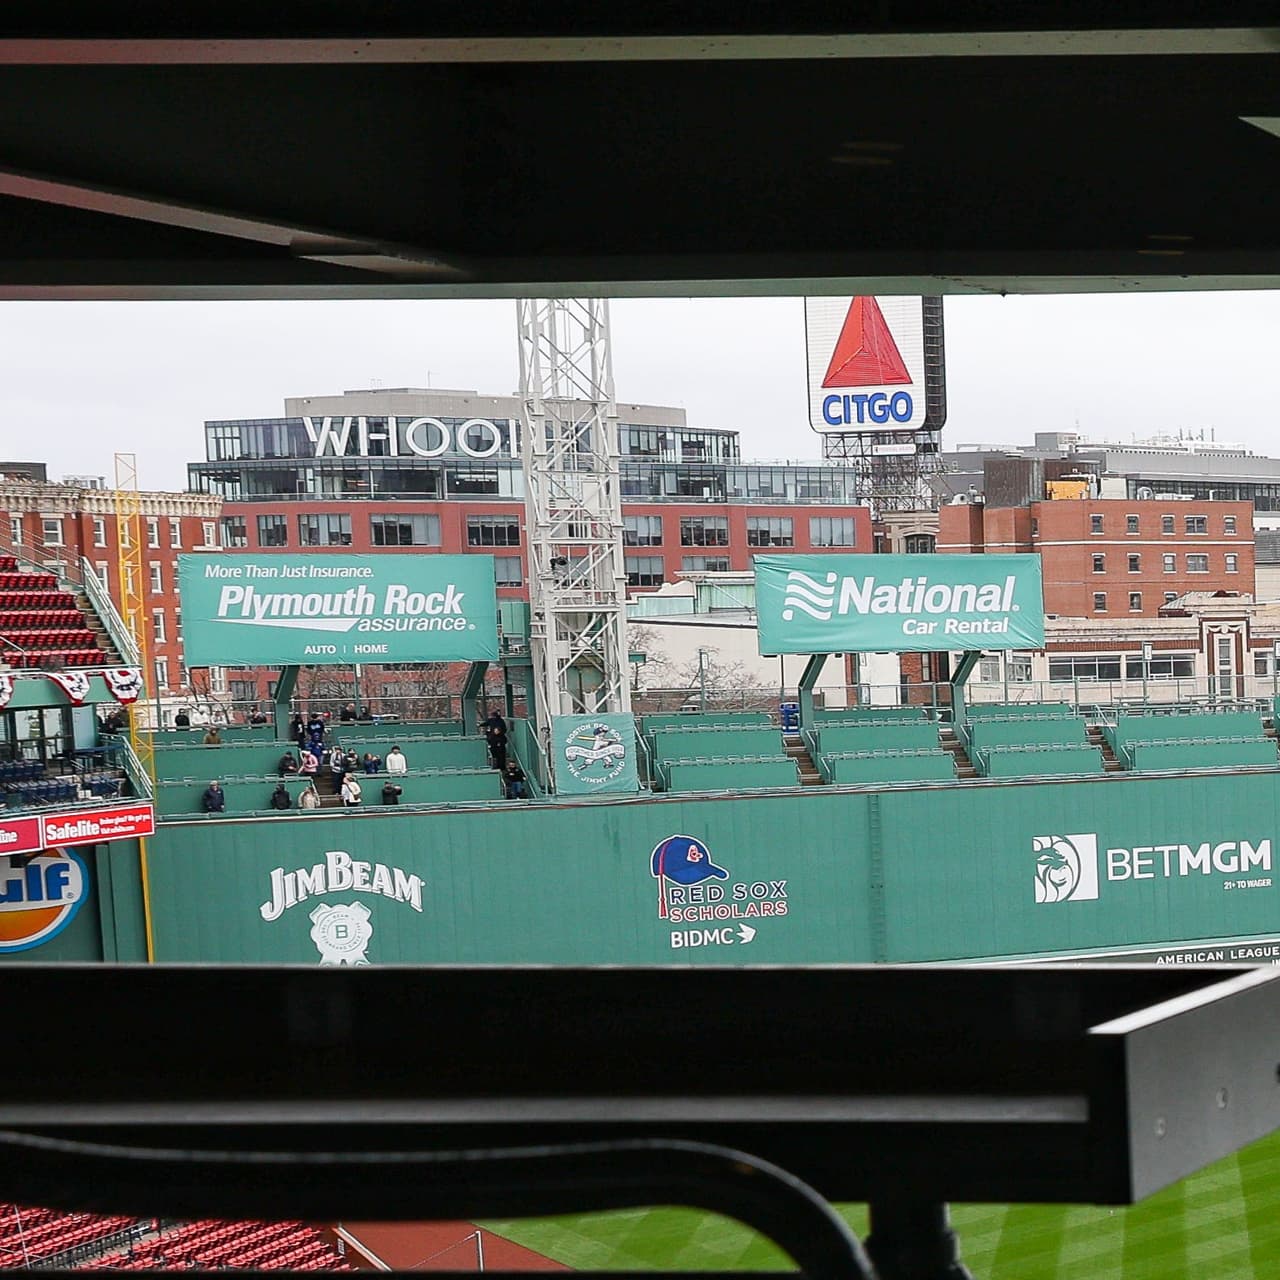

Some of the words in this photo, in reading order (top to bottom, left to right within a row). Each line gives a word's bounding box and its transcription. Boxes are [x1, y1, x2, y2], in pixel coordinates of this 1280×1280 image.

[822, 391, 914, 425] CITGO
[205, 565, 242, 577] More
[245, 565, 278, 577] Than
[279, 565, 307, 577] Just
[309, 565, 374, 577] Insurance.
[217, 585, 375, 620] Plymouth
[384, 584, 465, 615] Rock
[838, 576, 1014, 615] National
[358, 617, 466, 632] assurance
[902, 620, 938, 635] Car
[944, 616, 1009, 635] Rental
[304, 645, 336, 655] AUTO
[354, 644, 389, 655] HOME
[566, 723, 591, 744] BOSTON
[567, 763, 580, 778] THE
[581, 776, 608, 784] JIMMY
[609, 760, 625, 778] FUND
[46, 820, 100, 840] Safelite
[1106, 839, 1272, 881] BETMGM
[260, 863, 327, 922] JIM
[325, 851, 424, 913] BEAM
[670, 884, 725, 905] RED
[733, 880, 788, 901] SOX
[1224, 881, 1235, 890] 21+
[1237, 880, 1247, 889] TO
[1247, 878, 1272, 888] WAGER
[670, 901, 788, 923] SCHOLARS
[335, 925, 349, 939] B
[671, 928, 734, 948] BIDMC
[1156, 950, 1224, 965] AMERICAN
[1230, 946, 1280, 960] LEAGUE
